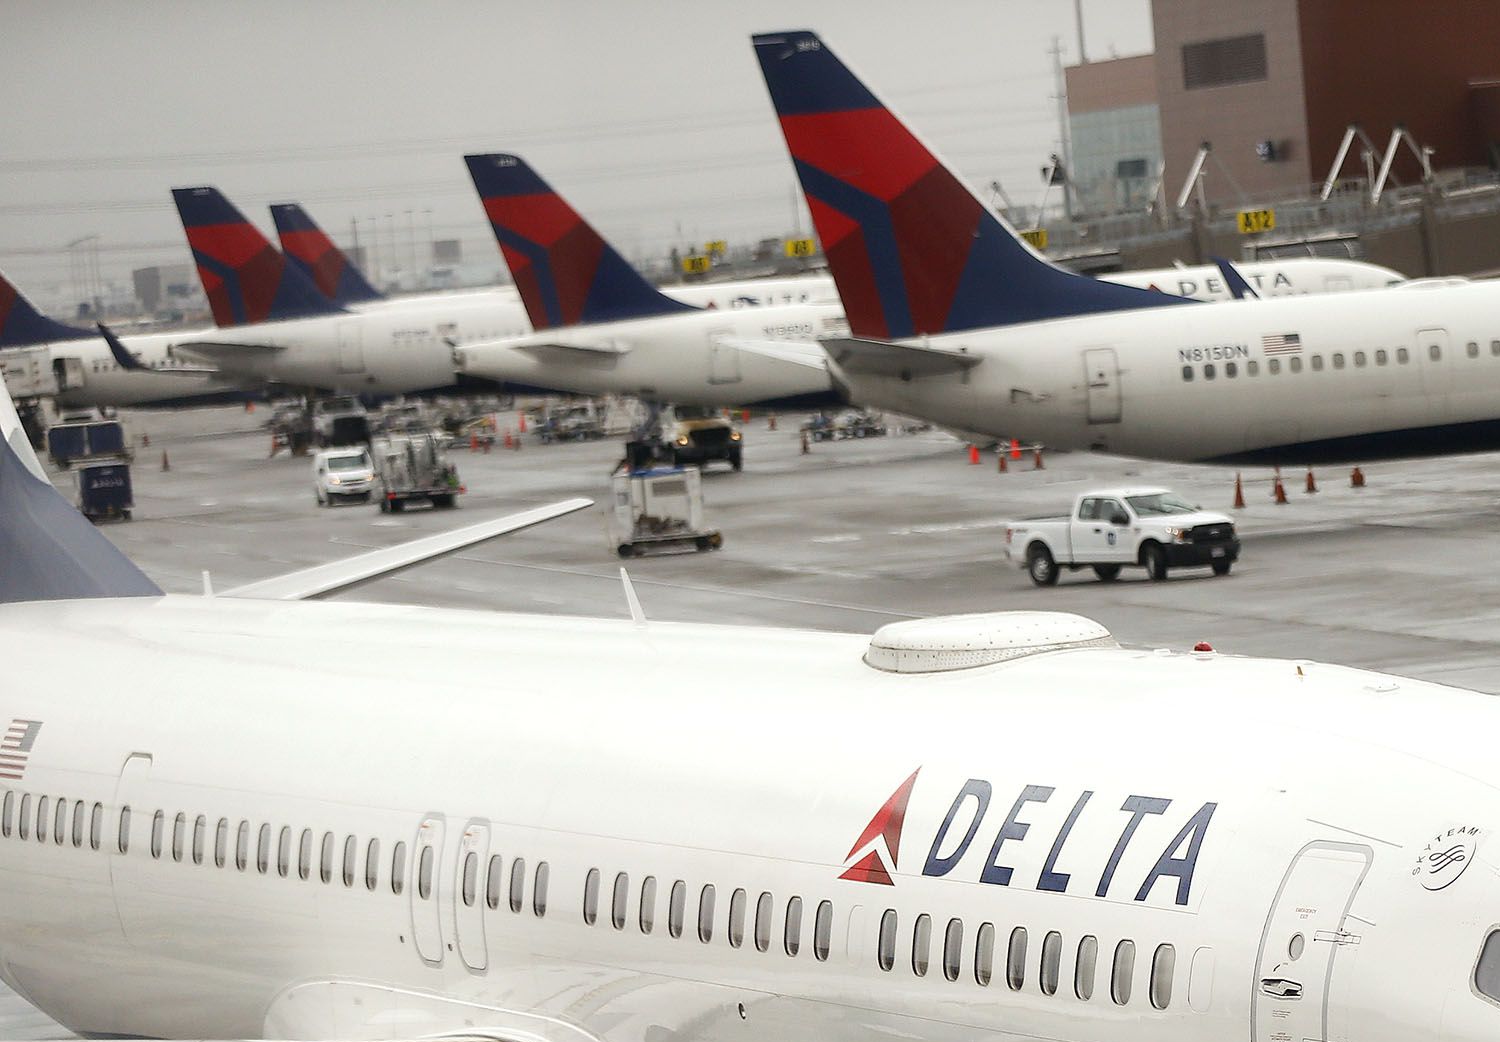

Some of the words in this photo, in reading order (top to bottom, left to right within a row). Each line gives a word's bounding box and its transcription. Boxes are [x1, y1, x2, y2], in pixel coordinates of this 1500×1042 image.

[1242, 211, 1271, 233] A12
[1178, 272, 1292, 297] DETA
[1178, 344, 1249, 362] N815DN
[922, 778, 1218, 906] DELTA
[1411, 825, 1480, 876] SKYTEAM
